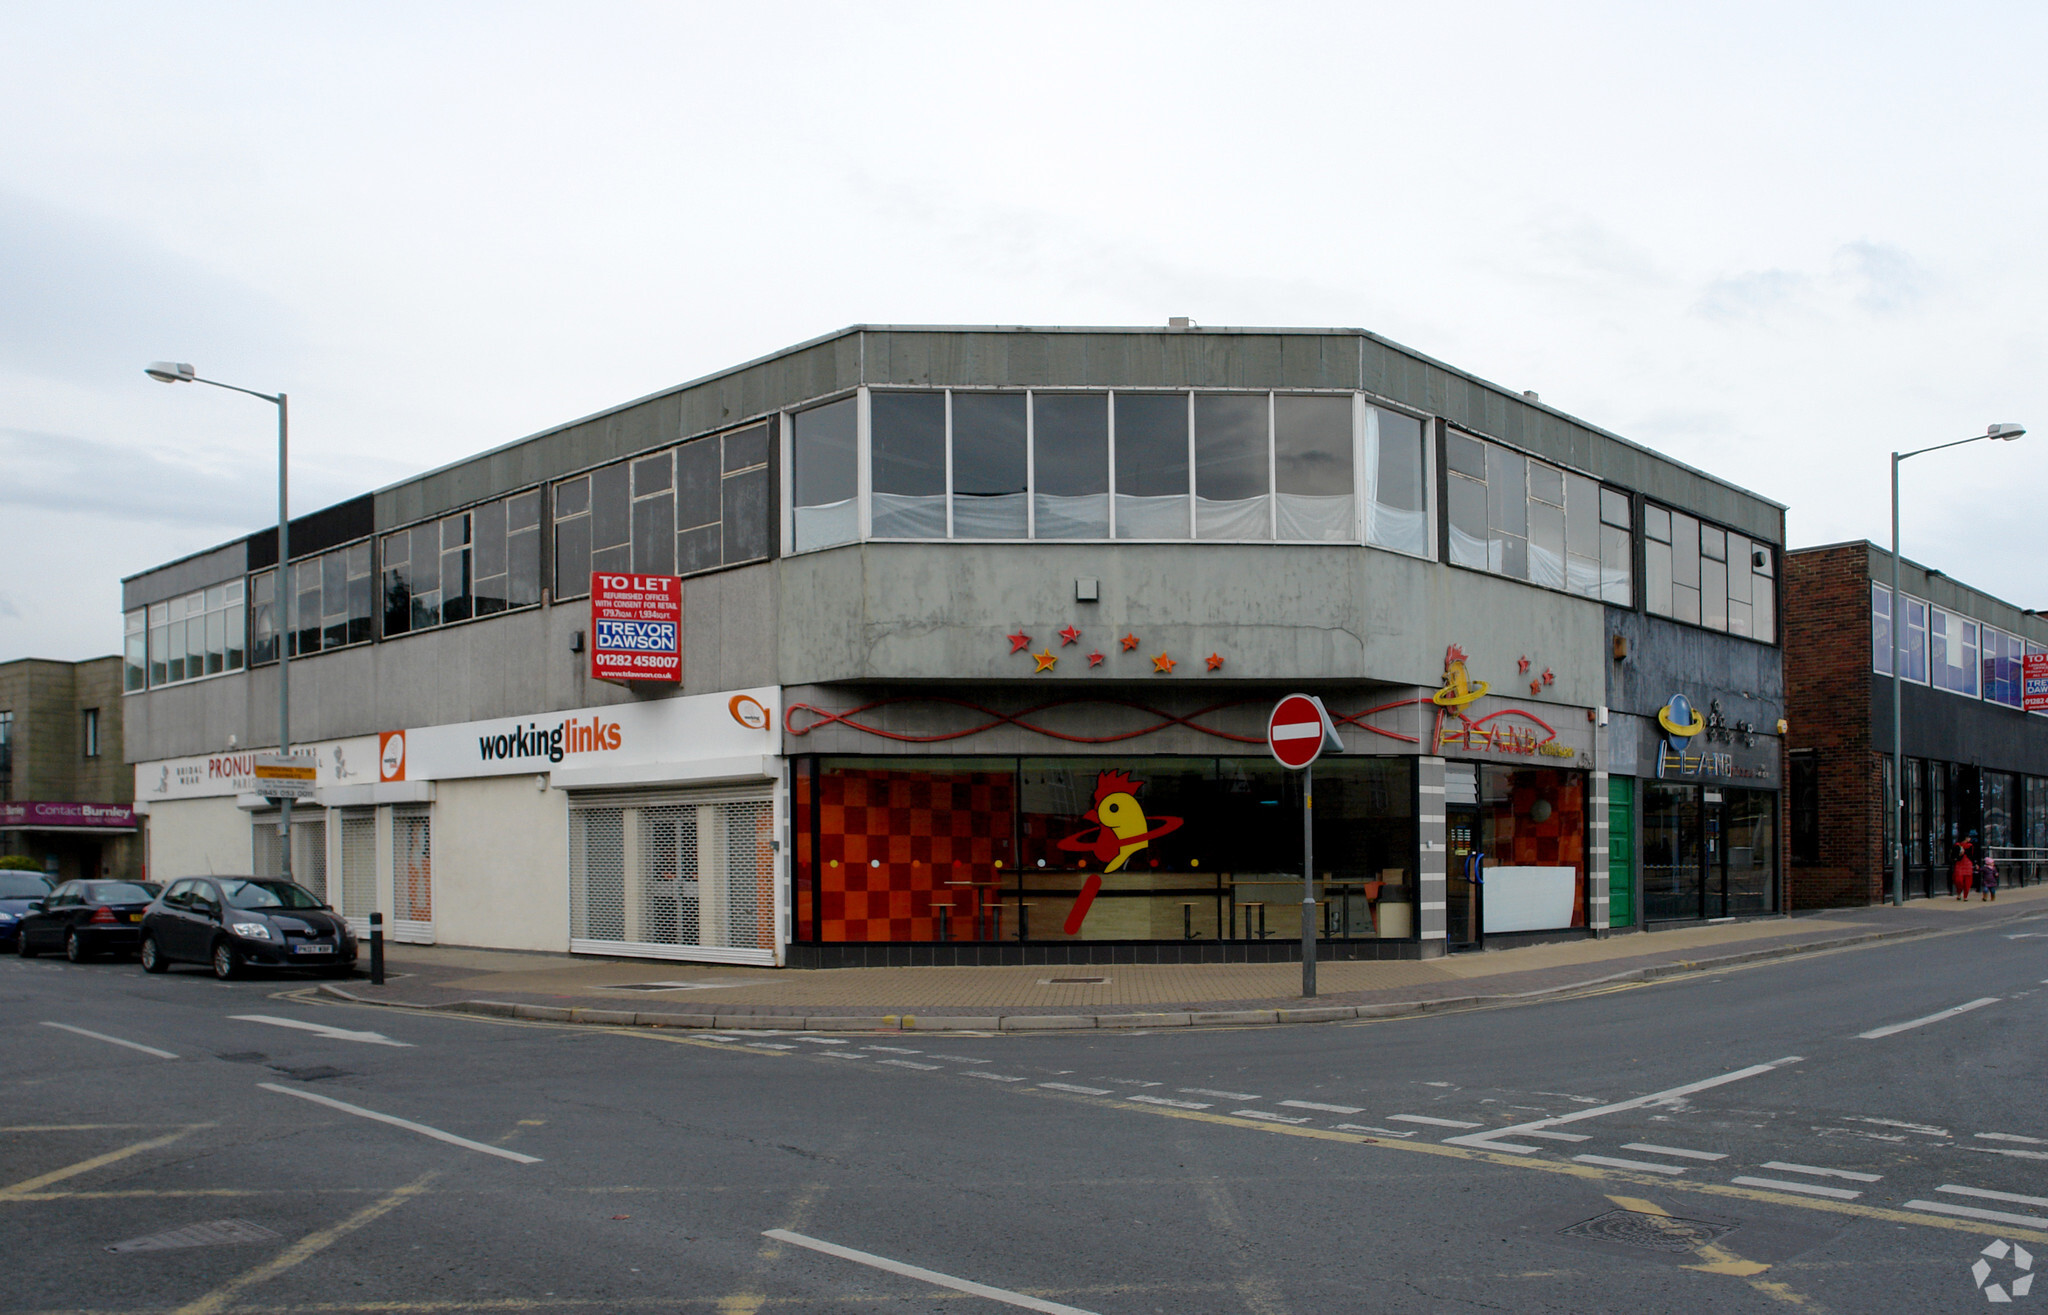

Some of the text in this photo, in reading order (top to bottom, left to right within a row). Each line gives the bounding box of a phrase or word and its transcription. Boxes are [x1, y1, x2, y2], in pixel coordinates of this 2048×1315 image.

[599, 576, 671, 591] TO LET
[603, 591, 669, 601] REFURBISHED OFFICES
[613, 600, 642, 608] CONSENT
[658, 602, 678, 610] RETAIL
[599, 621, 673, 637] TREVOR
[599, 634, 674, 650] DAWSON
[596, 653, 679, 668] 01282 458007
[176, 766, 203, 776] BRIDAL
[180, 777, 200, 785] WEAR
